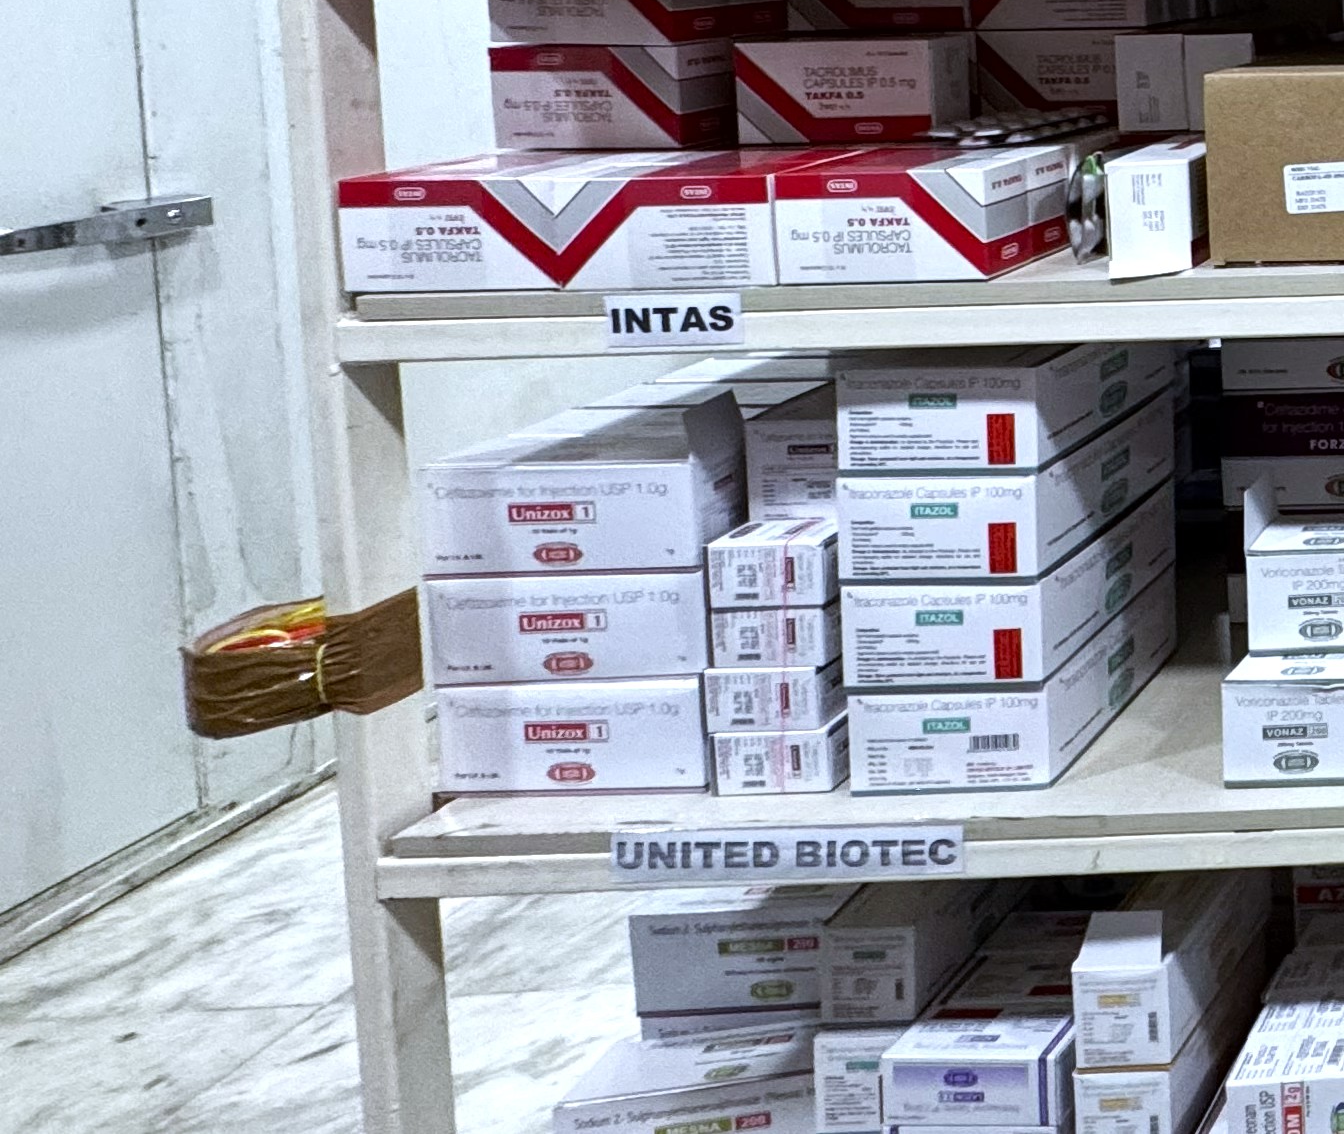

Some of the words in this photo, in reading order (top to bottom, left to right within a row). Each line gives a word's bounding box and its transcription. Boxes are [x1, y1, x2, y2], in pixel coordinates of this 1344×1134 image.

[610, 306, 735, 333] INTAS
[912, 397, 952, 406] ITAZOL
[511, 506, 571, 520] Unizox
[915, 506, 954, 516] ITAZOL
[1292, 596, 1329, 607] VONAZ
[522, 616, 582, 630] Unizox
[919, 613, 960, 623] ITAZOL
[927, 720, 967, 730] ITAZOL
[527, 726, 585, 740] Unizox
[1266, 727, 1304, 739] VONAZ
[614, 841, 781, 870] UNITED
[796, 839, 958, 866] BIOTEC
